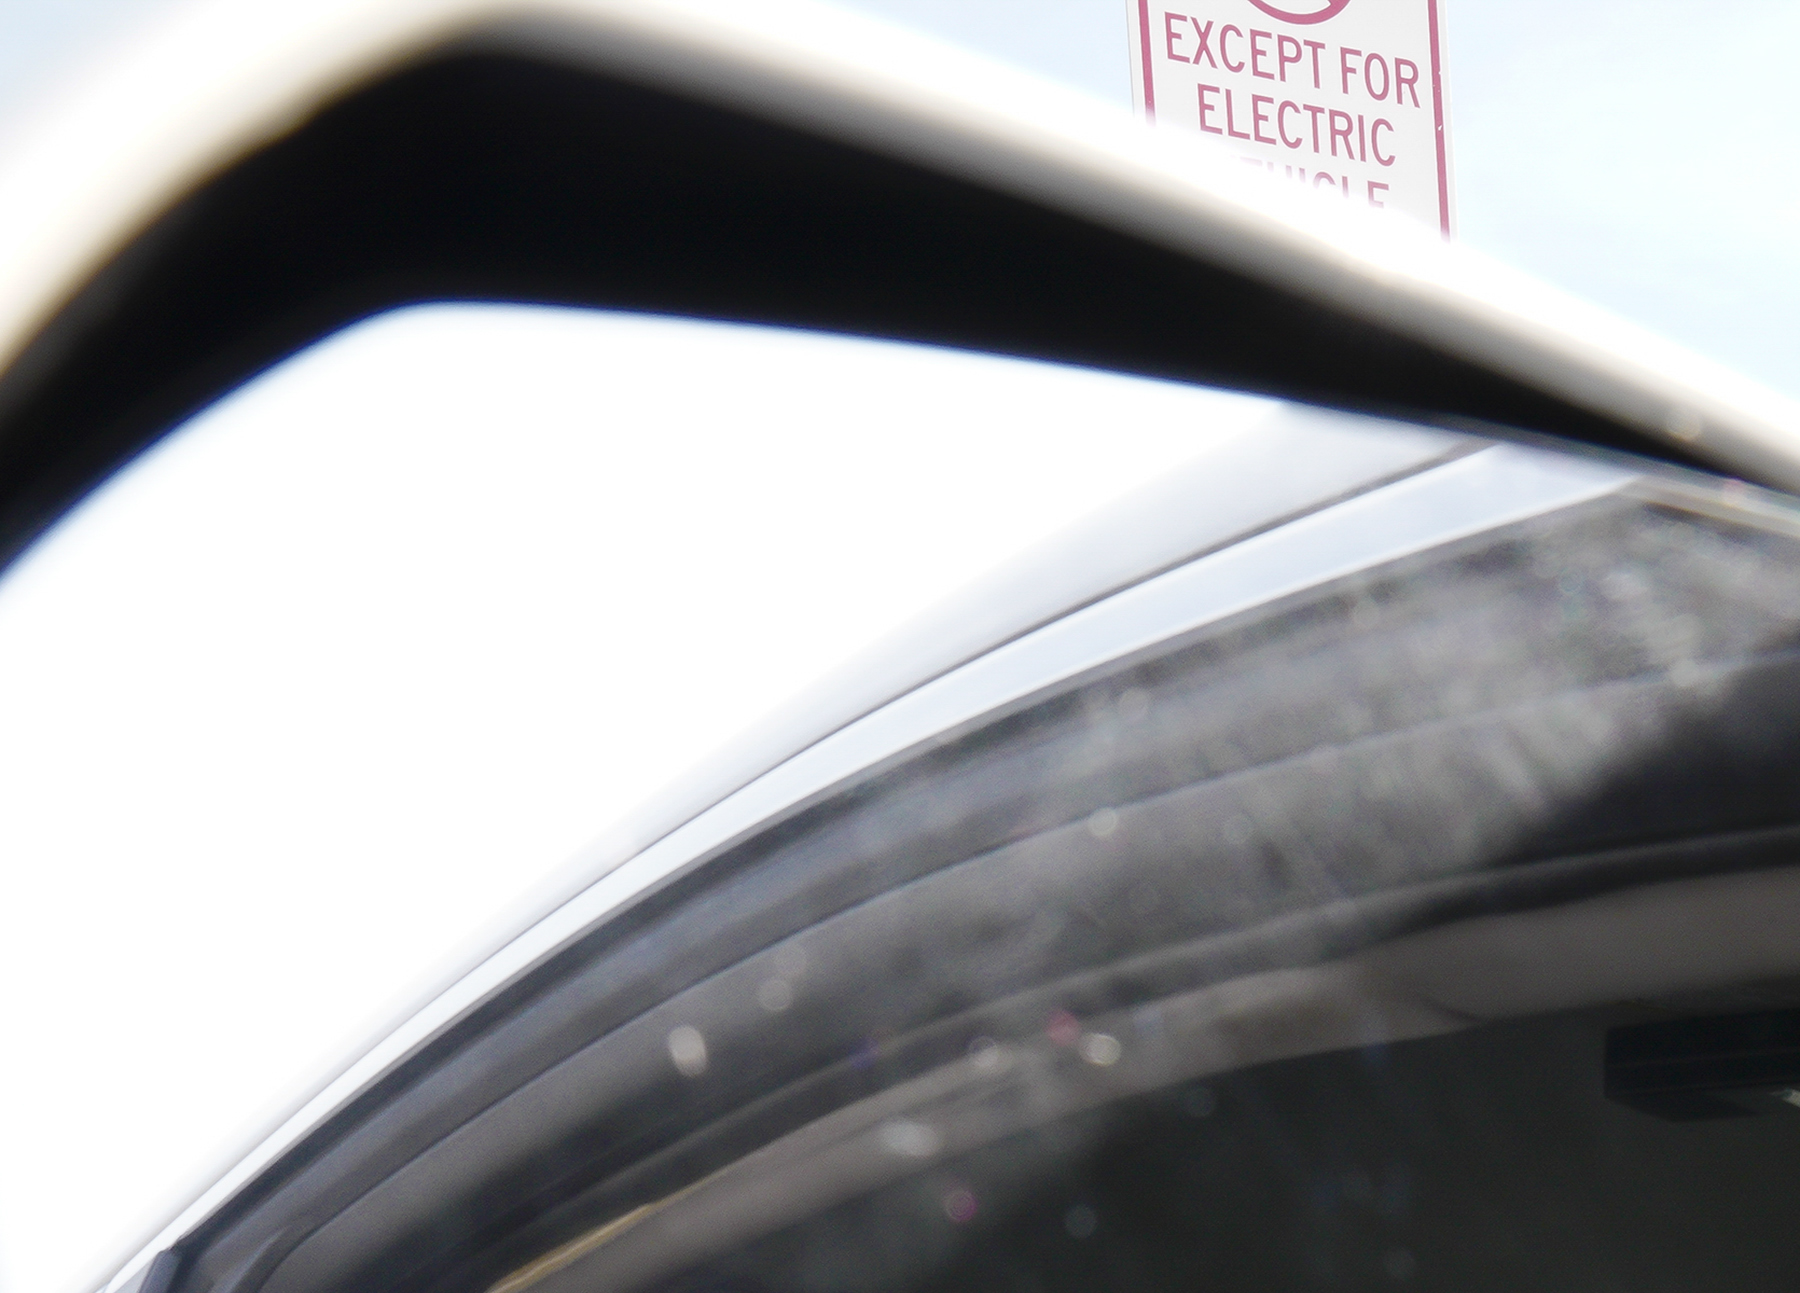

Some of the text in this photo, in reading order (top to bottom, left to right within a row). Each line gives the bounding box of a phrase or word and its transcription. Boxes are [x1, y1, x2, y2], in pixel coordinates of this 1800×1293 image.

[1164, 11, 1421, 108] EXCEPT FOR
[1197, 82, 1396, 167] ELECTRIC
